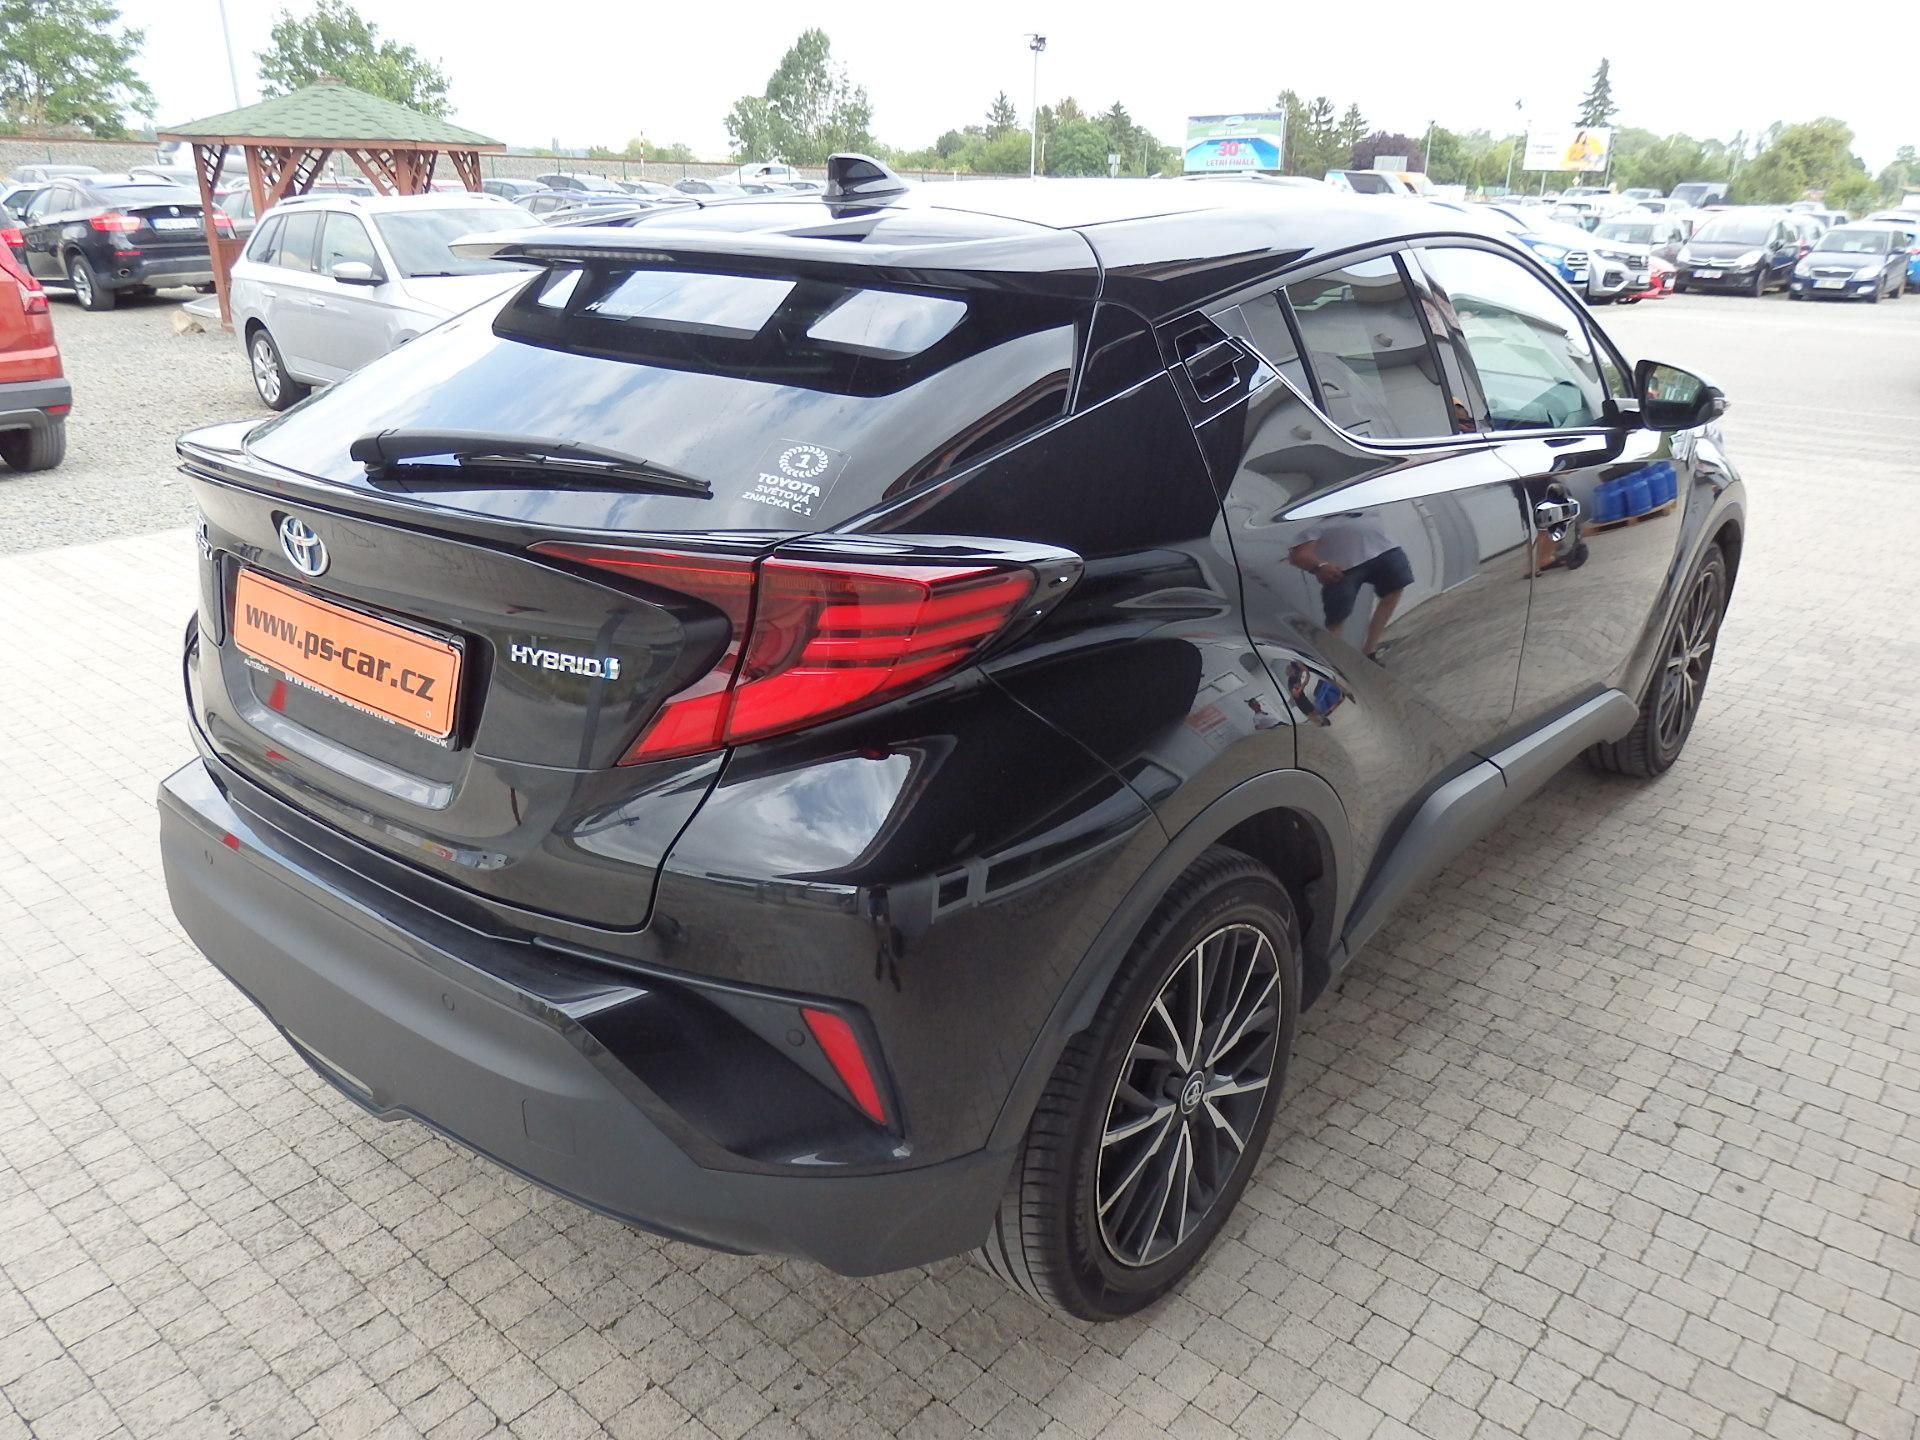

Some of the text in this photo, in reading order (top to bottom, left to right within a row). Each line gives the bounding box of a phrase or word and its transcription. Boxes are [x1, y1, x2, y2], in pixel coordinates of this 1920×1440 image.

[759, 472, 820, 497] TOYOTA
[246, 603, 436, 702] www.ps-car.cz
[511, 644, 602, 678] HYBRID
